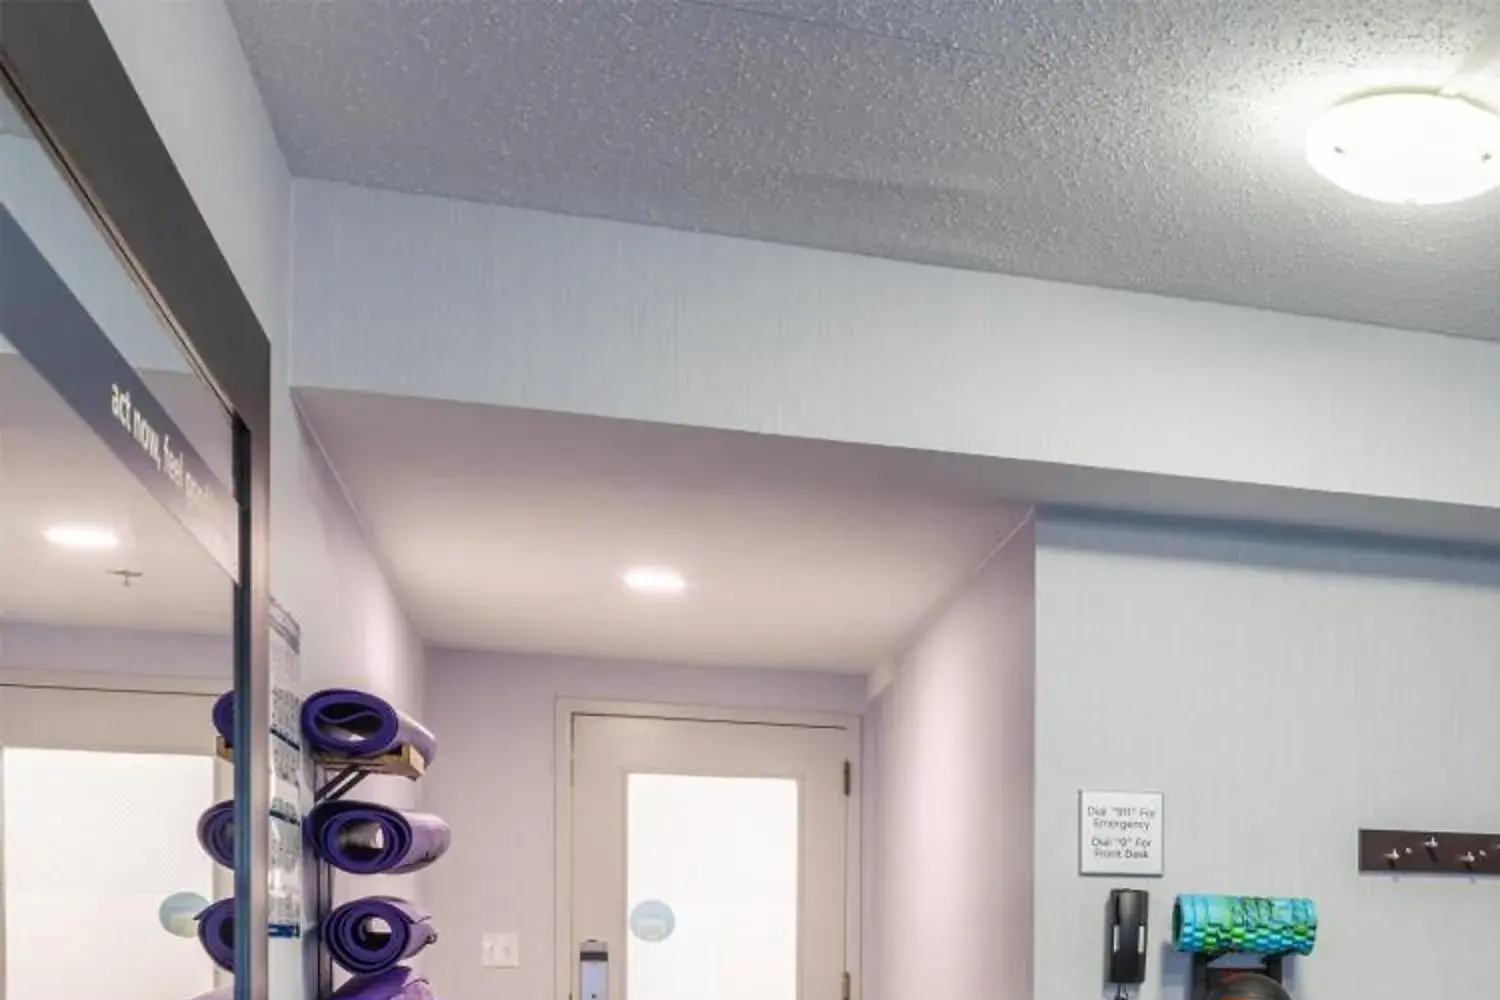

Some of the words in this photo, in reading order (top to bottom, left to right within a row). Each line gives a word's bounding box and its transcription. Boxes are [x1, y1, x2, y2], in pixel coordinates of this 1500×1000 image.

[111, 383, 132, 434] act
[1087, 805, 1107, 818] Dial
[1140, 807, 1155, 819] For
[1093, 817, 1151, 831] Emergency
[1136, 837, 1152, 849] For
[1095, 849, 1122, 859] Front
[1125, 848, 1148, 860] Desk
